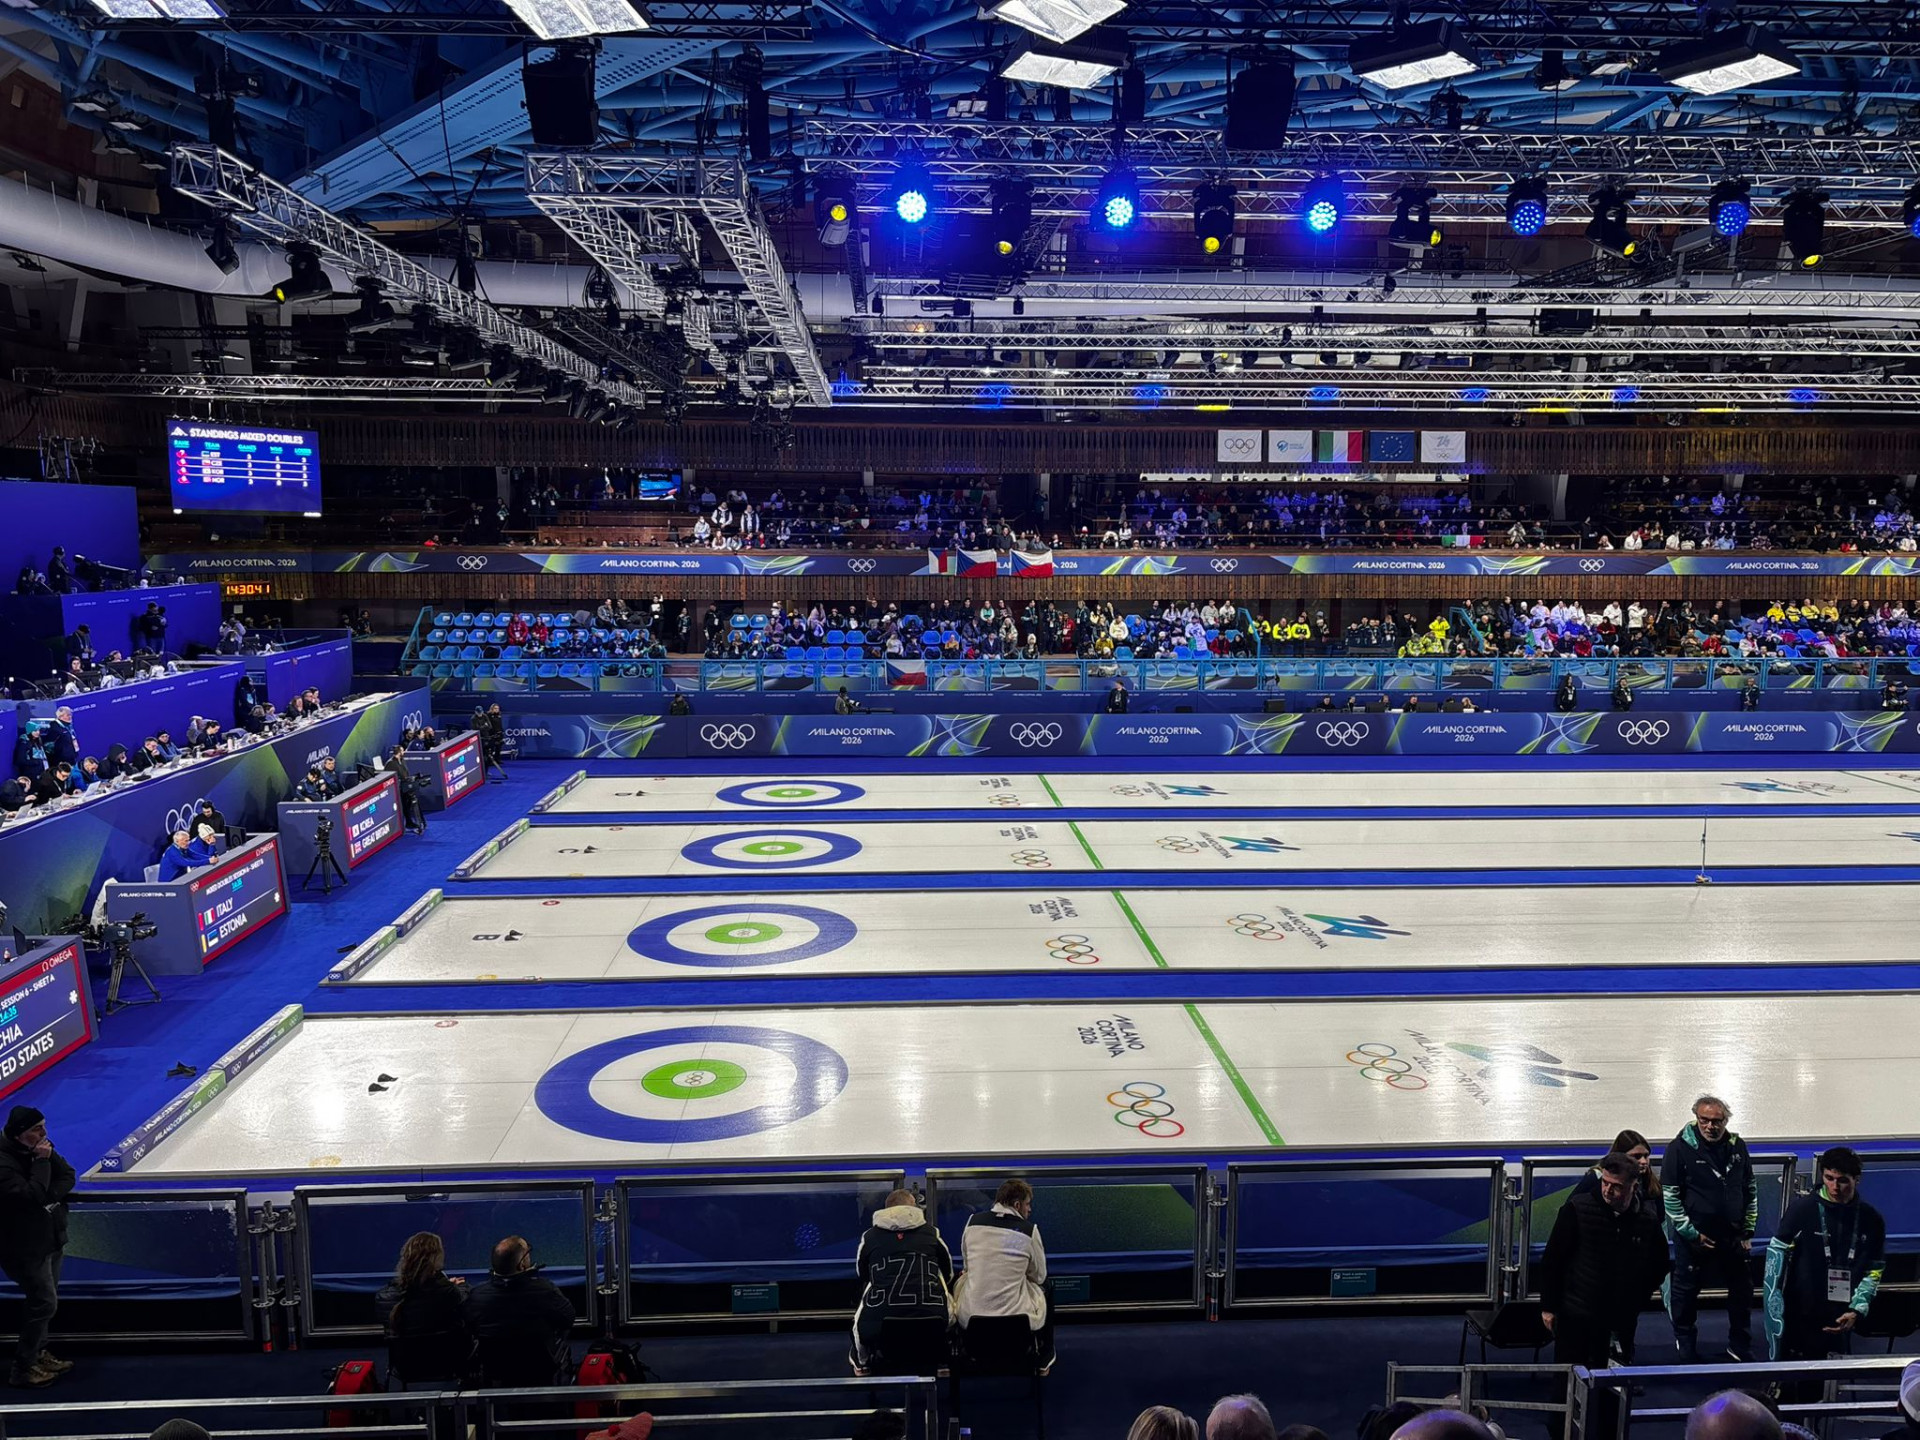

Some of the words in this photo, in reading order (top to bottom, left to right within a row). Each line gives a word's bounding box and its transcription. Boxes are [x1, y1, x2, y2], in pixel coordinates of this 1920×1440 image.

[190, 428, 239, 440] STANDINGS
[240, 432, 266, 442] MIXED
[267, 434, 303, 444] DOUBLES
[188, 559, 232, 568] MILANO
[233, 559, 276, 567] CORTINA
[640, 560, 680, 568] CORTINA
[681, 560, 700, 568] 2026
[1061, 561, 1078, 569] 2026
[808, 728, 850, 736] MILANO
[852, 728, 895, 736] CORTINA
[1722, 724, 1763, 732] MILANO
[1765, 724, 1806, 732] CORTINA
[1455, 734, 1475, 742] 2026
[306, 745, 330, 764] MILANO
[362, 832, 376, 848] GREAT
[216, 897, 233, 917] ITALY
[219, 912, 248, 939] ESTONIA
[49, 949, 73, 968] OMEGA
[1, 990, 24, 1010] SESSION
[25, 988, 29, 996] 6
[33, 975, 49, 991] SHEET
[50, 974, 55, 982] A
[1078, 1027, 1100, 1044] 2026
[1096, 1020, 1125, 1058] CORTINA
[1112, 1014, 1145, 1050] MILANO
[18, 1032, 54, 1067] STATES
[866, 1252, 944, 1307] CZE
